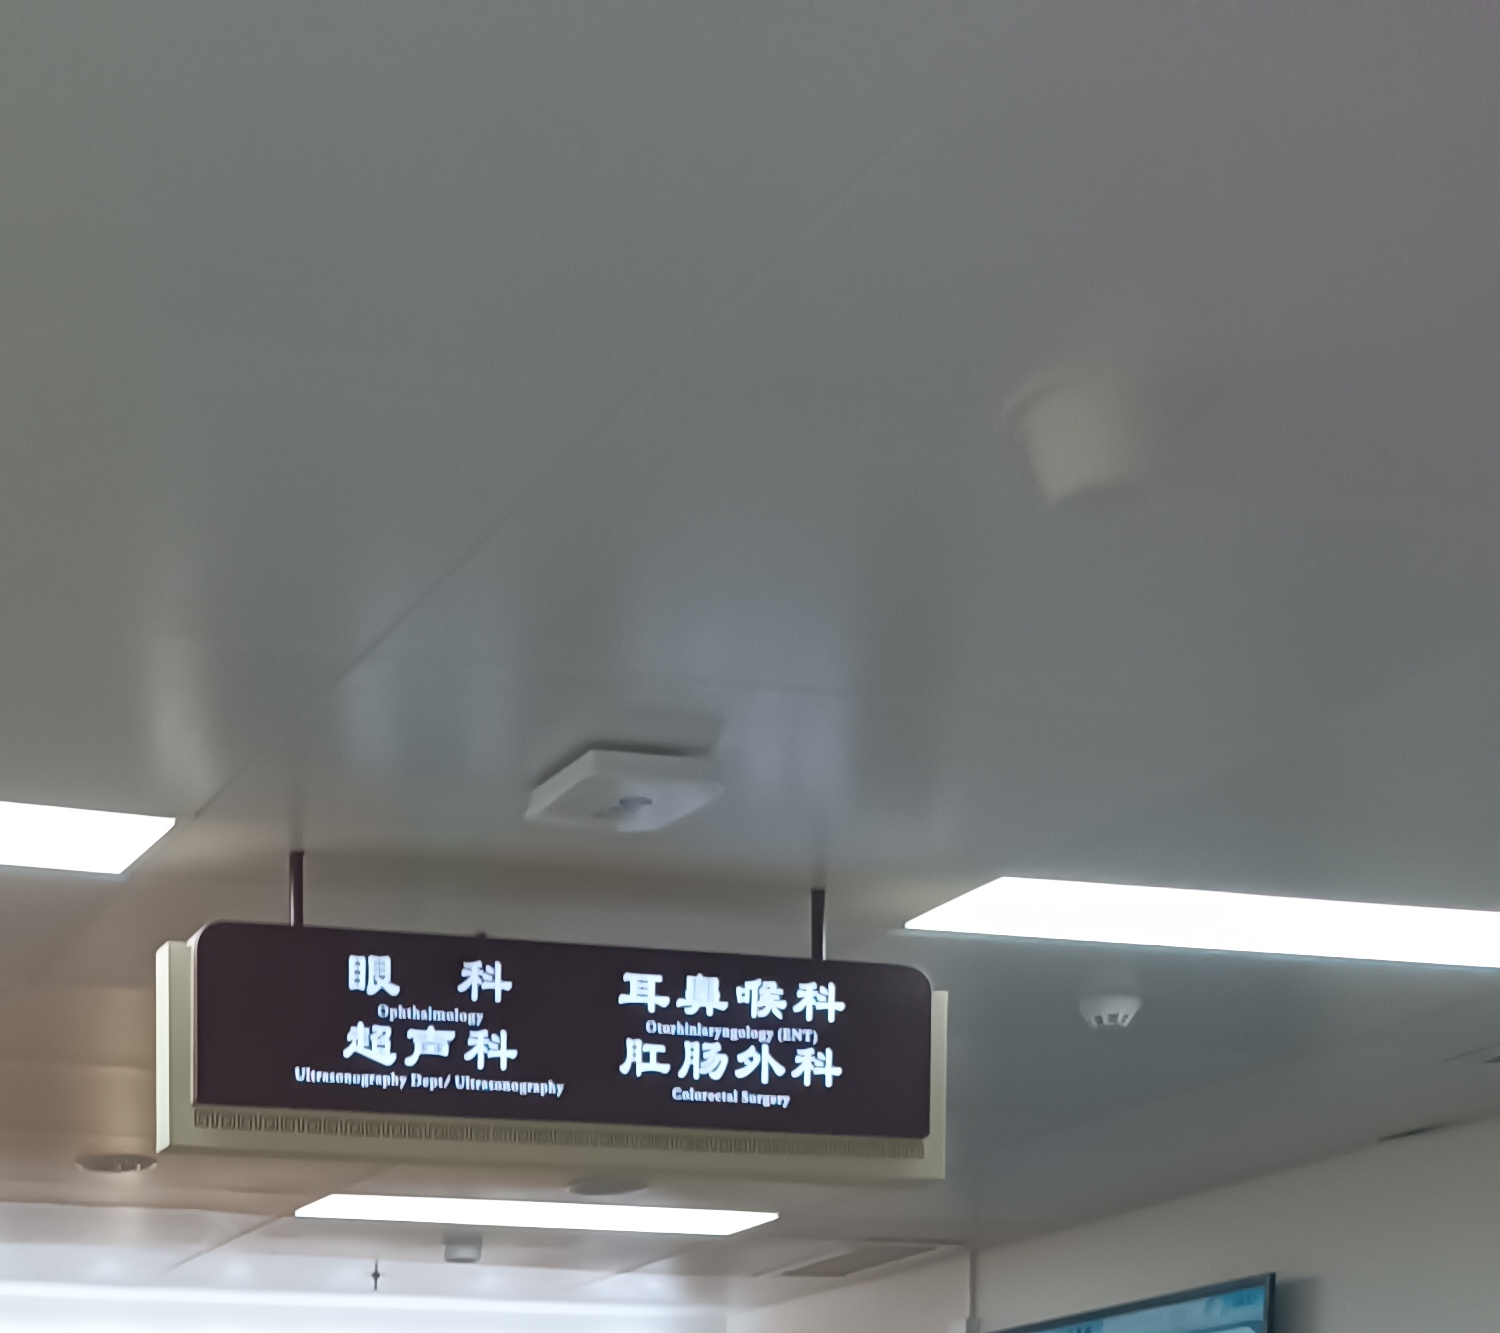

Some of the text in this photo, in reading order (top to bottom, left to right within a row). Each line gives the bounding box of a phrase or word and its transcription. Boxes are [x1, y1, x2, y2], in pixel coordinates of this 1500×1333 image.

[617, 971, 846, 1024] 耳鼻喉科
[376, 1003, 484, 1027] Ophthalmology
[342, 1020, 518, 1072] 超声科
[777, 1027, 819, 1045] (ENT)
[618, 1037, 843, 1089] 肛肠外科
[294, 1065, 408, 1092] Ultrasonography
[454, 1073, 565, 1099] Ultrasonography
[741, 1090, 791, 1109] Surgery
